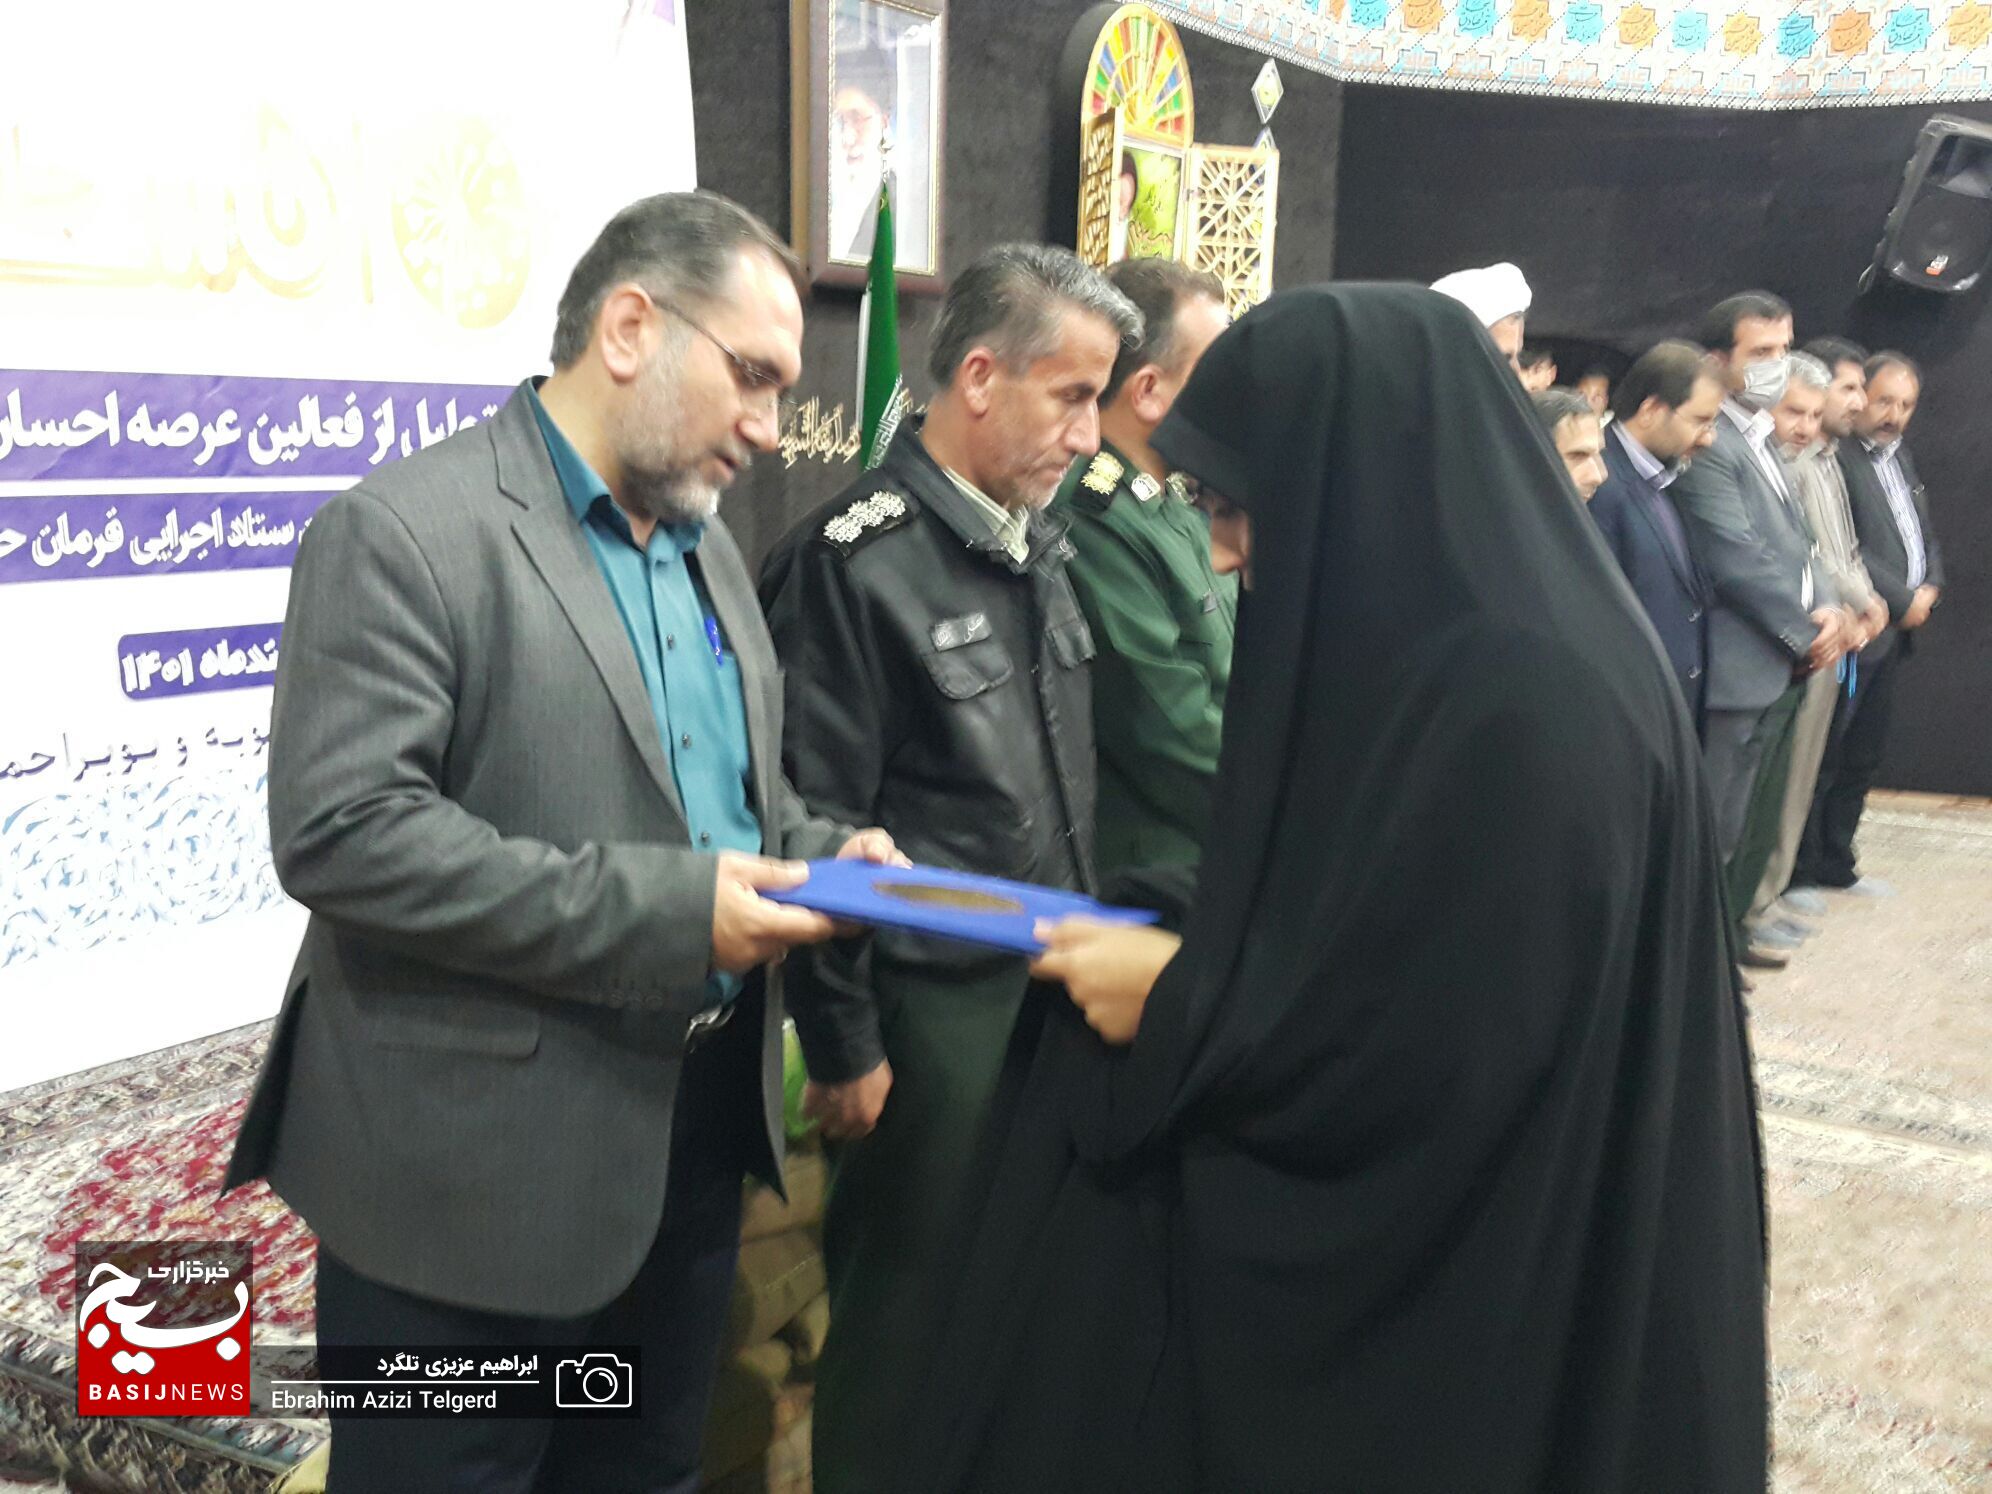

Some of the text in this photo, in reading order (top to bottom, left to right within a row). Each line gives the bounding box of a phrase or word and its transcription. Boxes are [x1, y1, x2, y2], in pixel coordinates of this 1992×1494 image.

[127, 402, 242, 467] عرصه
[248, 391, 364, 467] فعالین
[368, 396, 396, 465] از
[31, 506, 125, 568] فرمان
[130, 506, 224, 566] اجرایی
[227, 506, 294, 548] ستاد
[121, 647, 194, 693] ۱۴۰۱
